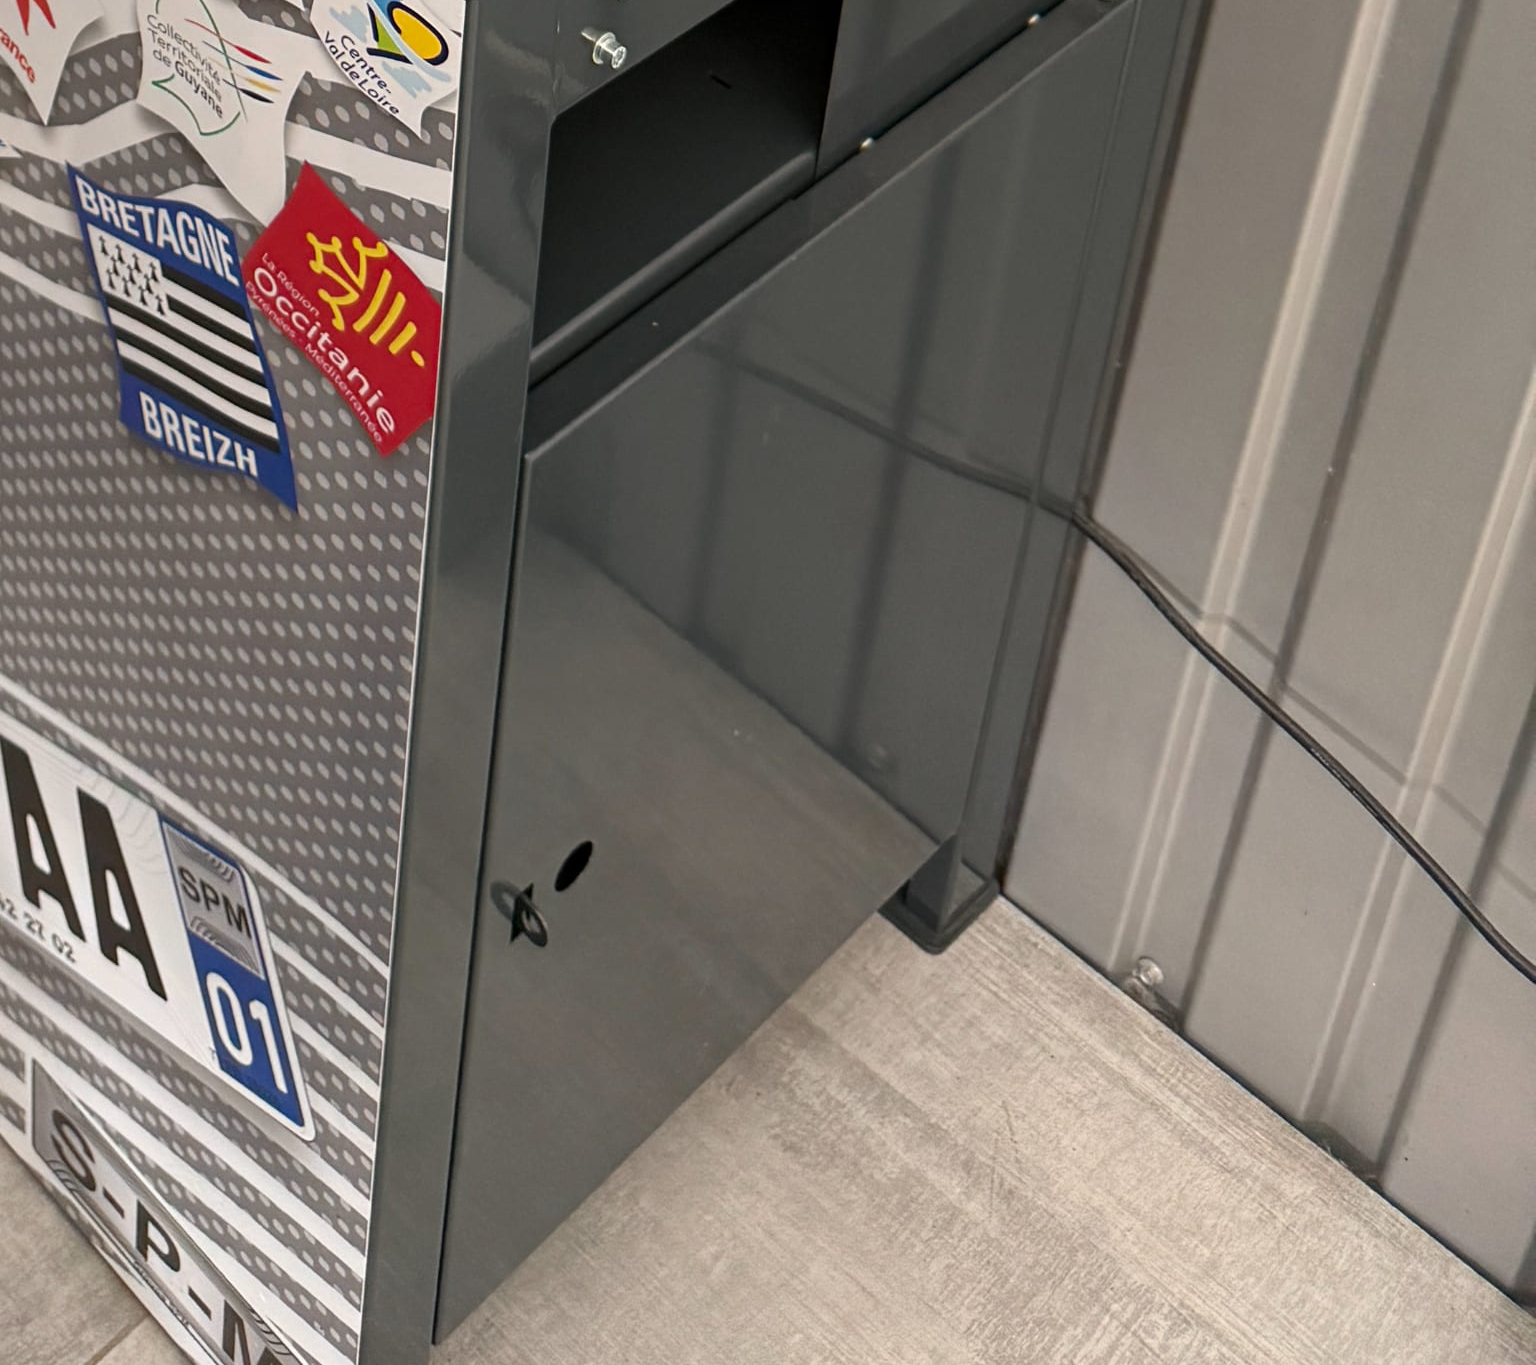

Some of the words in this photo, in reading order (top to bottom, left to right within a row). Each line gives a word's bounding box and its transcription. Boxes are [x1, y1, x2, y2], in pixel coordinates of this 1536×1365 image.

[154, 49, 172, 68] de
[174, 60, 223, 119] Guyane
[340, 35, 392, 95] Centre-
[75, 174, 240, 287] BRETAGNE
[261, 252, 277, 272] La
[276, 270, 320, 319] Région
[246, 280, 296, 340] Pyrénées
[304, 341, 383, 444] Méditerranée
[254, 267, 396, 436] Occitanie
[139, 391, 259, 477] BREIZH
[177, 866, 253, 940] SPM
[206, 972, 289, 1095] 01
